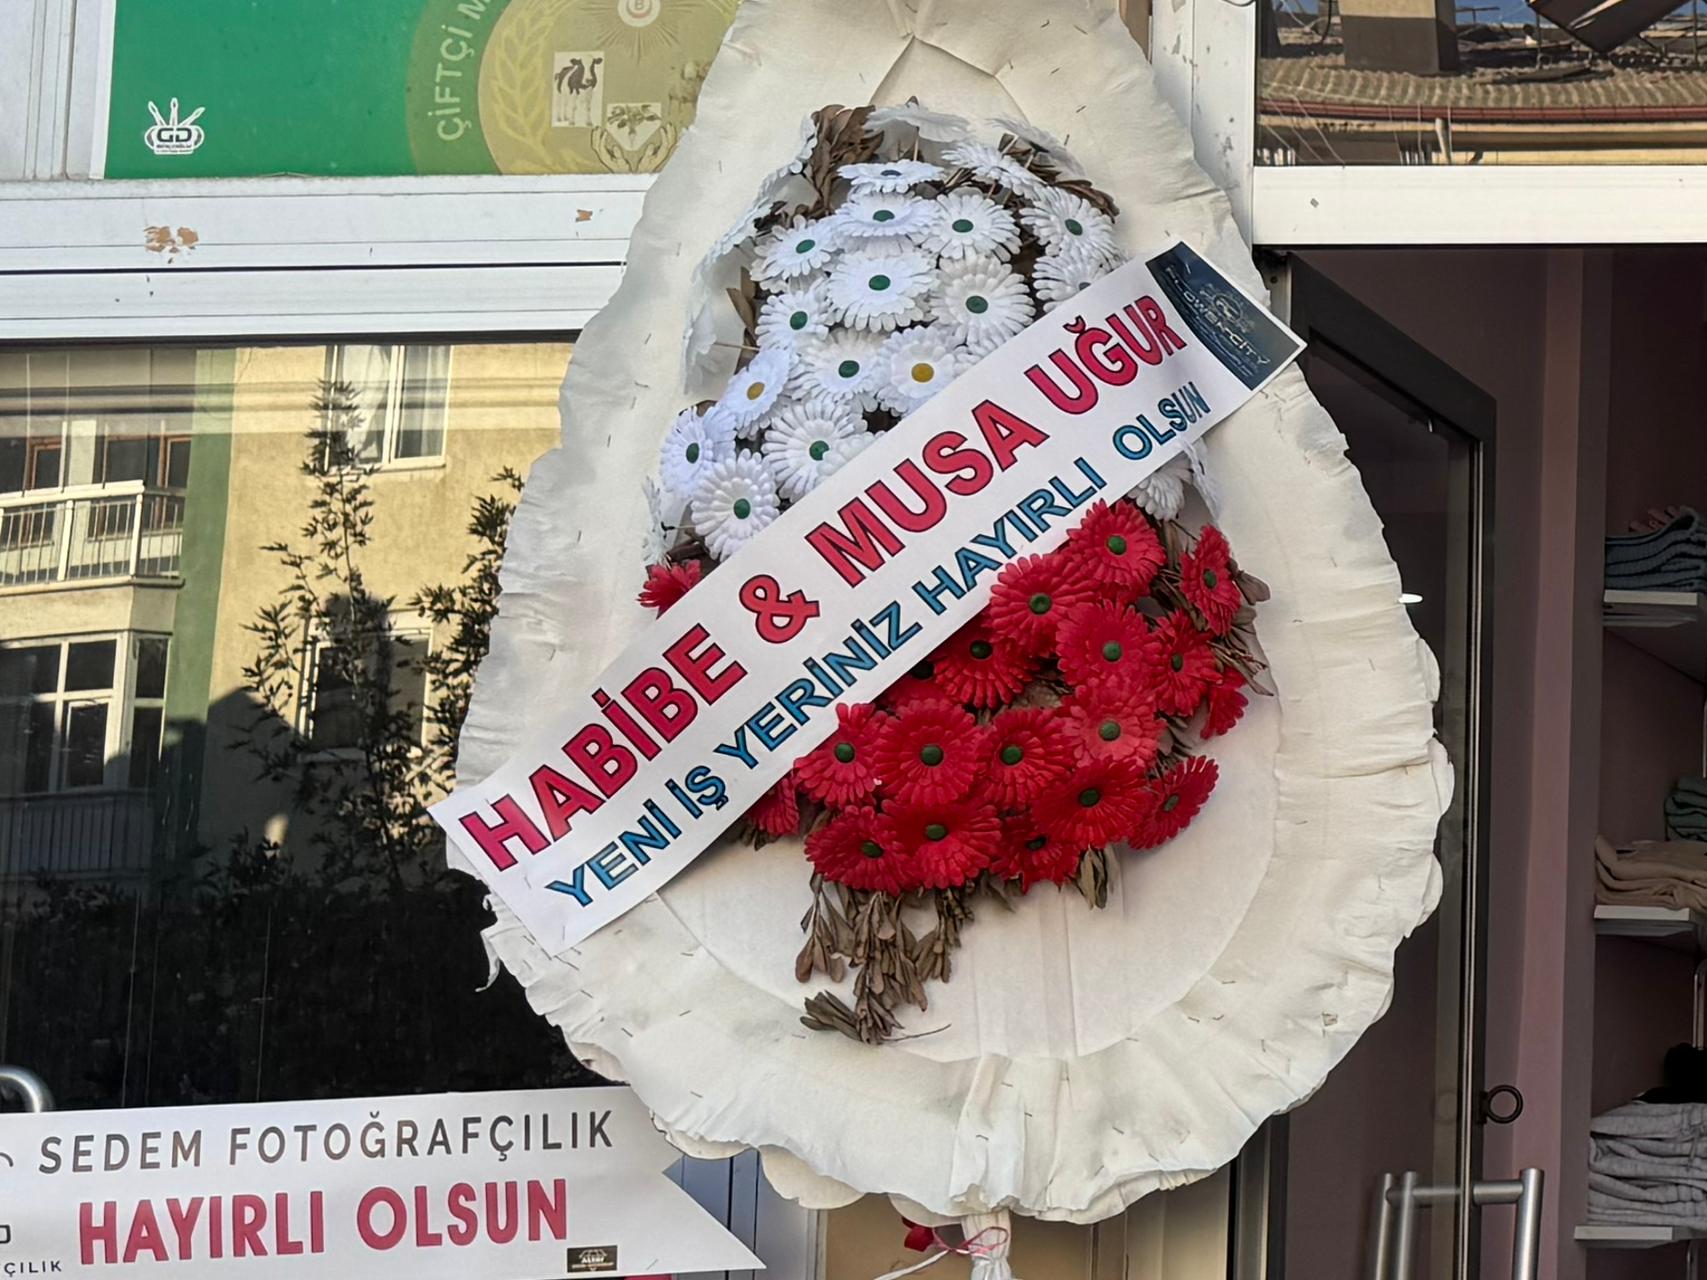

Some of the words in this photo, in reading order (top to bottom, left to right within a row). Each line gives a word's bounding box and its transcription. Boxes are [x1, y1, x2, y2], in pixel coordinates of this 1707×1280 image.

[427, 23, 475, 141] ÇİFTÇİ
[459, 624, 746, 872] HABİBE
[738, 575, 820, 643] &
[806, 397, 1050, 591] MUSA
[1025, 293, 1188, 416] UĞUR
[547, 796, 683, 908] YENİ
[666, 763, 731, 813] İŞ
[714, 600, 922, 770] YERİNİZ
[914, 457, 1107, 617] HAYIRLI
[1111, 380, 1211, 460] OLSUN
[39, 1129, 203, 1174] SEDEM
[229, 1109, 614, 1167] FOTOĞRAFÇILIK
[79, 1189, 325, 1265] HAYIRLI
[356, 1178, 568, 1251] OLSUN
